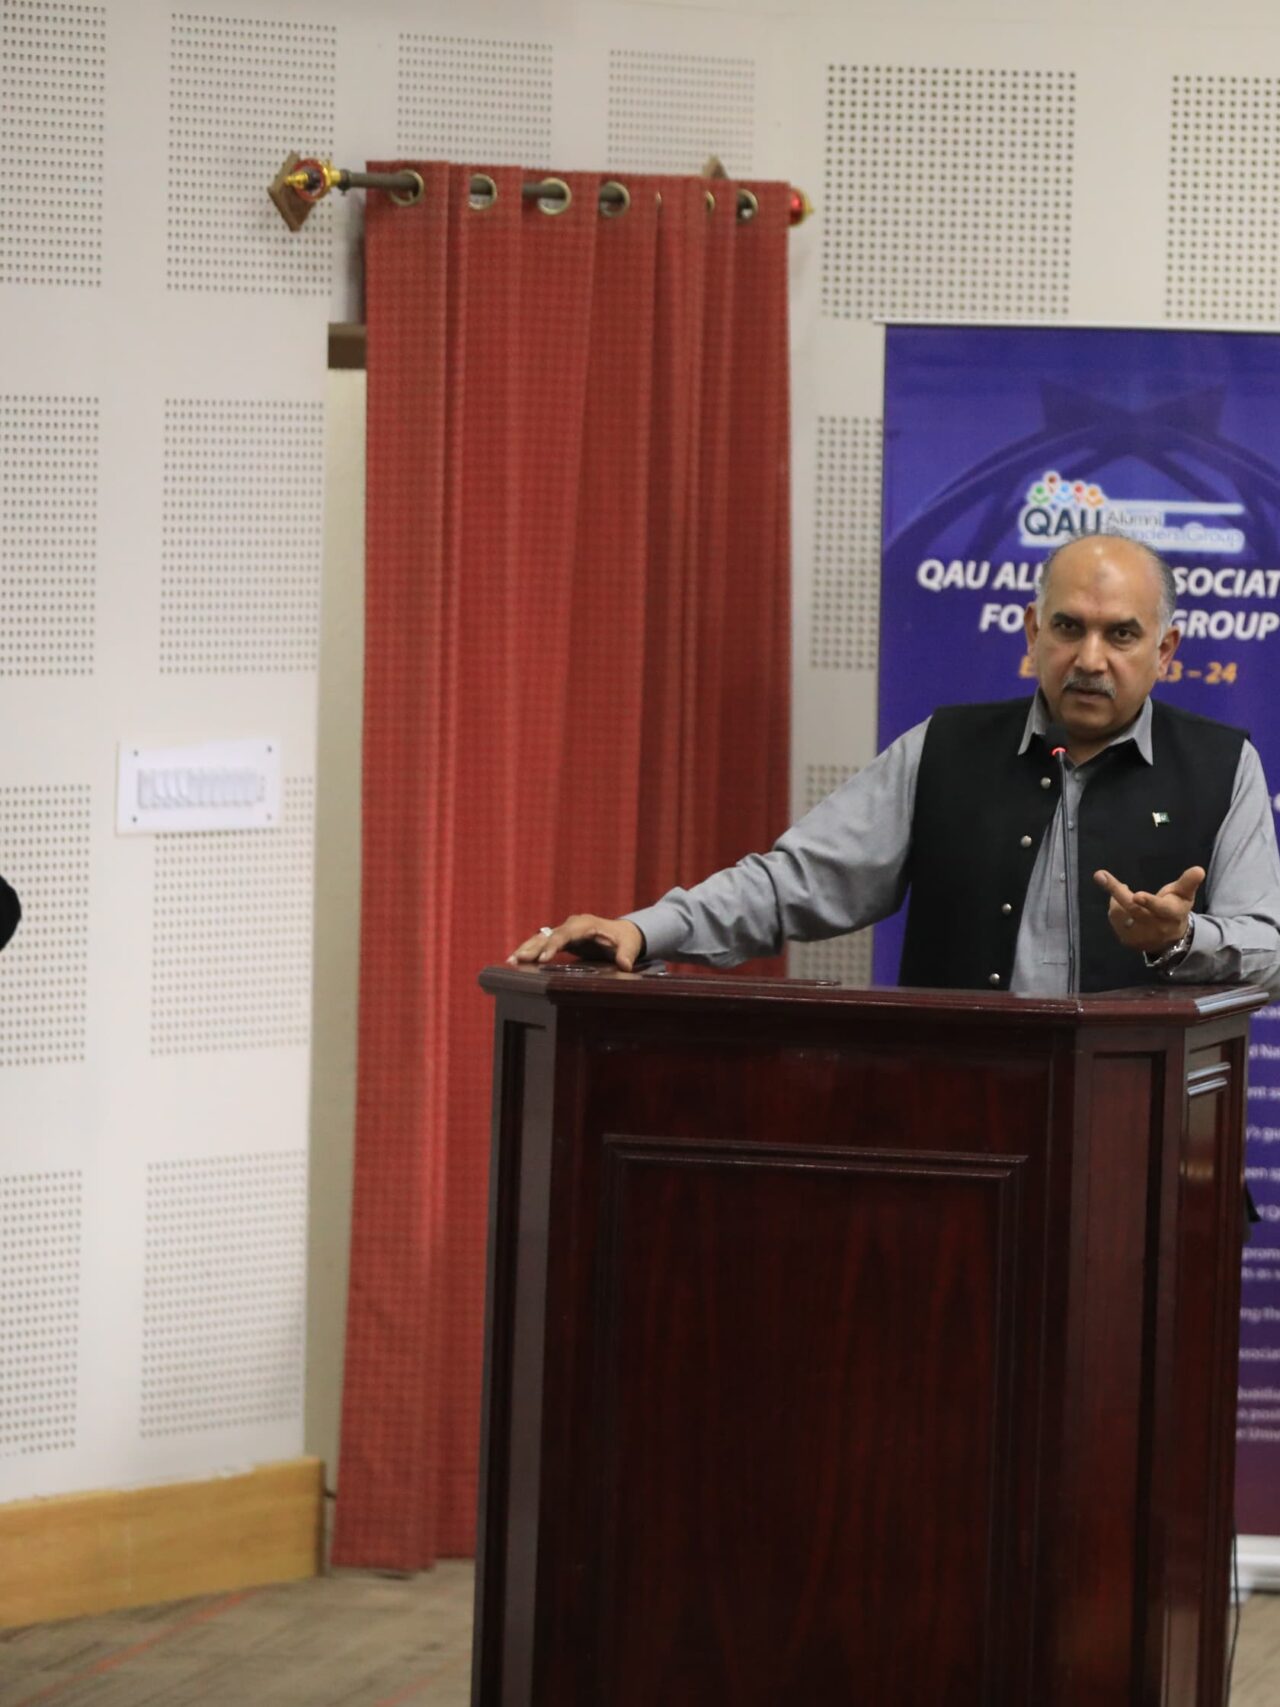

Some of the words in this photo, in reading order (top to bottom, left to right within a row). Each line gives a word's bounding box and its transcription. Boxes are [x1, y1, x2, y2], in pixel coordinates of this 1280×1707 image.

[1024, 508, 1101, 537] QAU
[1107, 510, 1162, 526] Alumni
[917, 559, 990, 592] QAU
